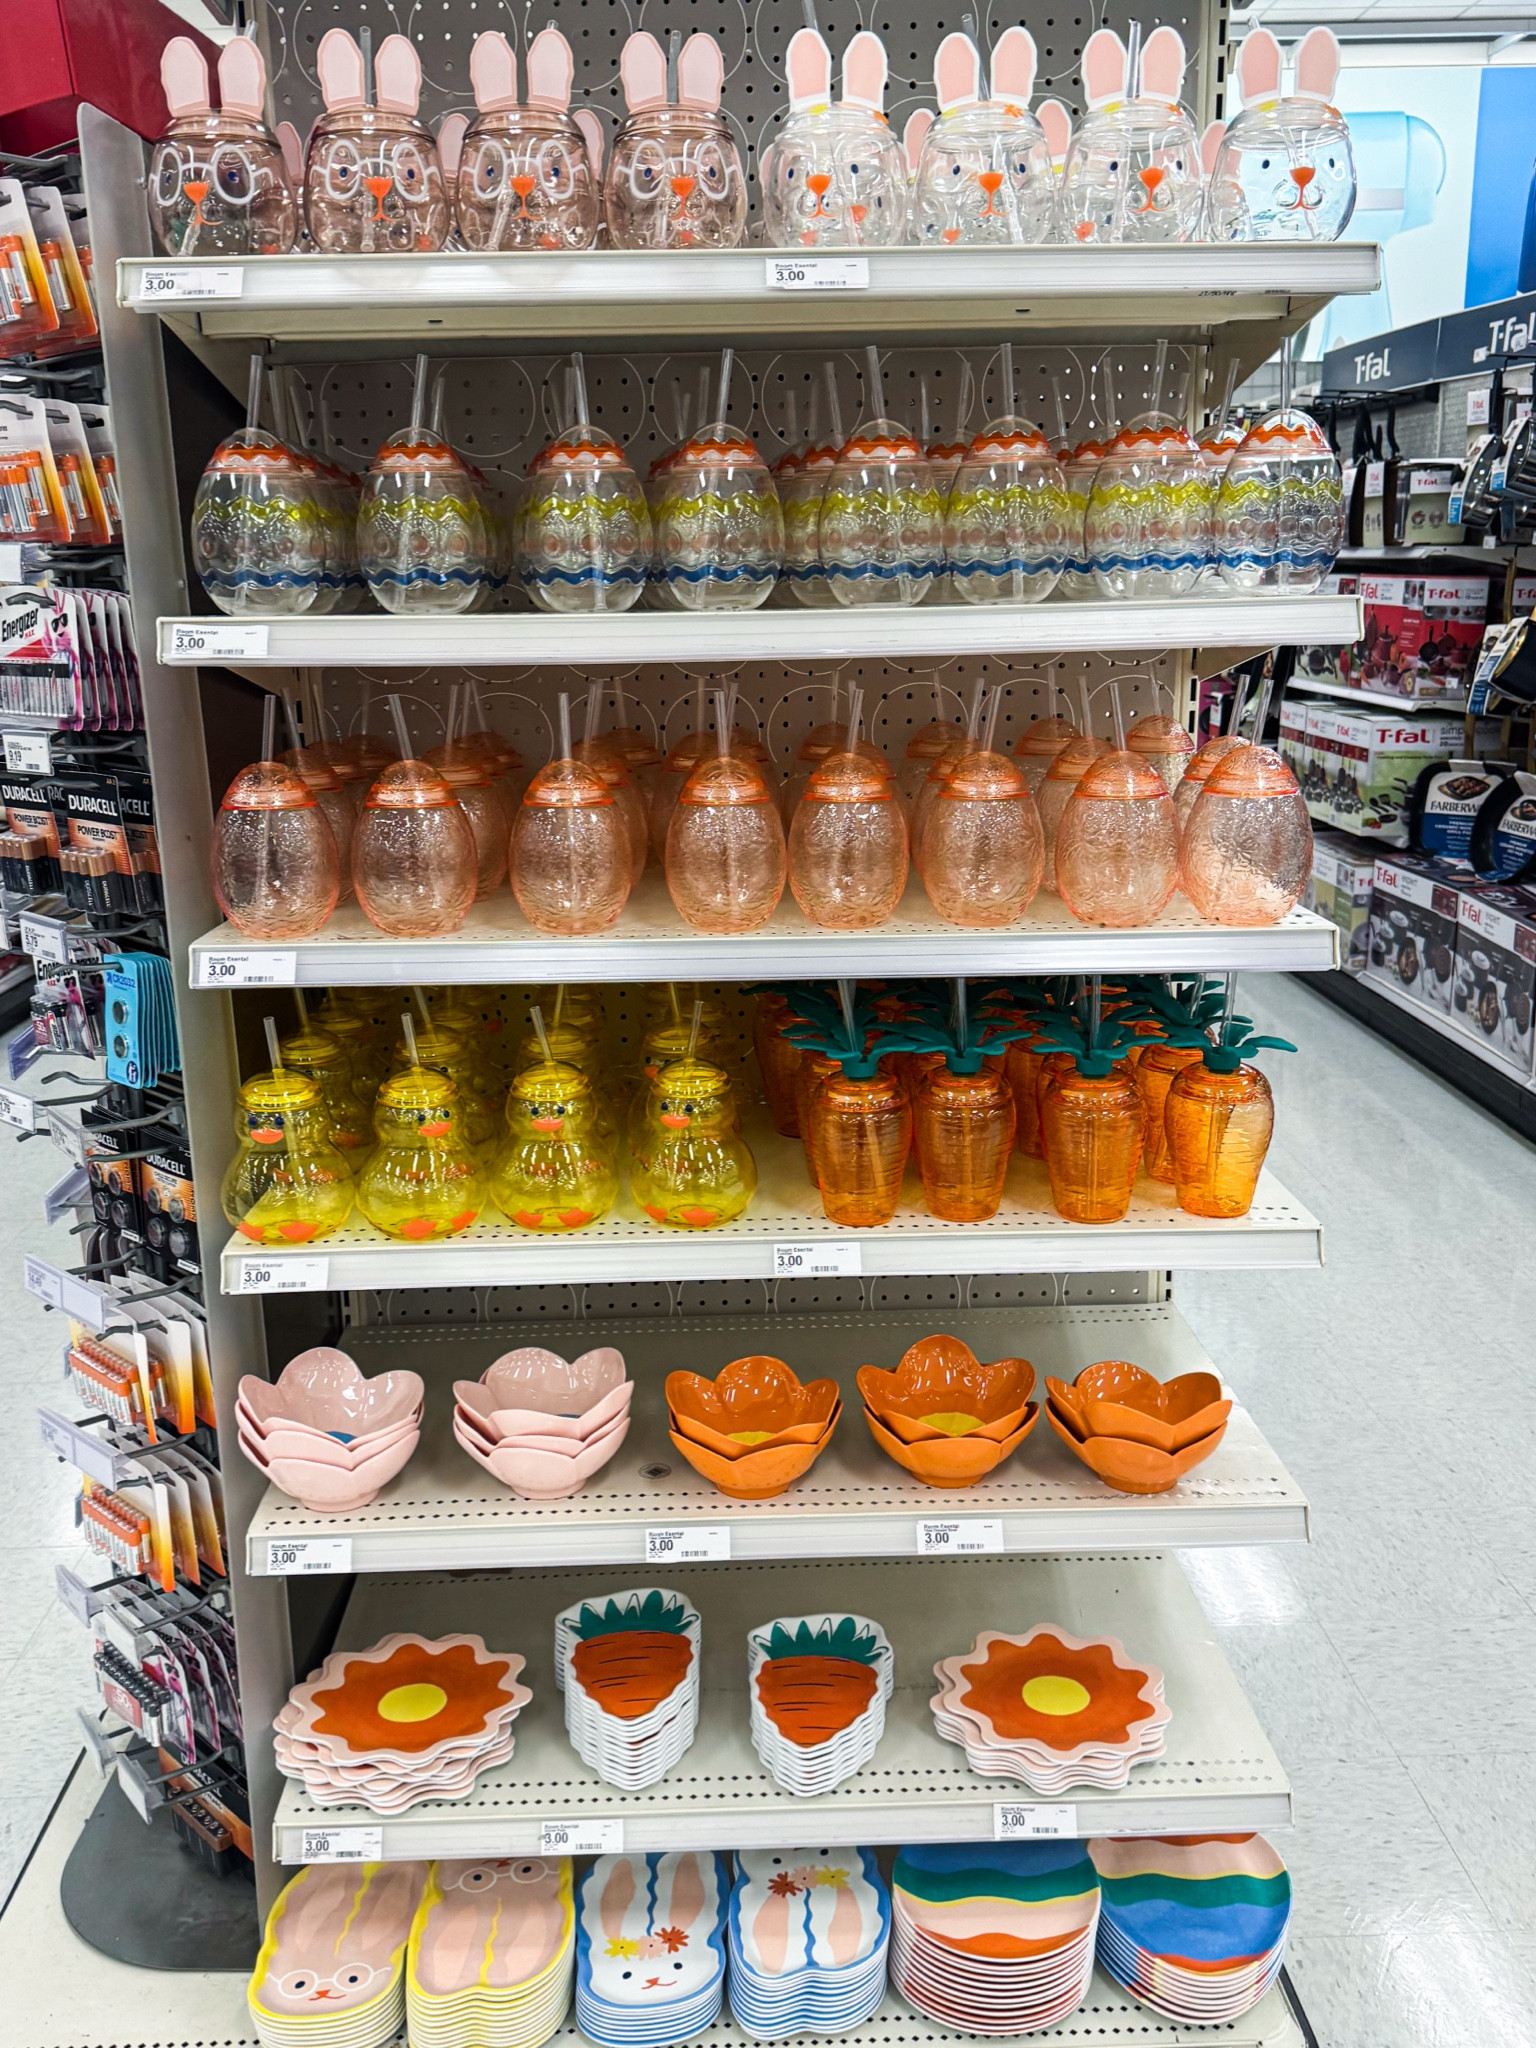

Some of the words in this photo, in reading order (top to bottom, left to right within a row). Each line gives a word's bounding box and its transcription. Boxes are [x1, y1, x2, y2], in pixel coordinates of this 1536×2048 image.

[776, 271, 805, 281] 3.00
[145, 280, 175, 290] 3.00
[1516, 588, 1536, 598] T-fa
[2, 608, 38, 643] Energizer
[176, 637, 205, 648] 3.00
[1440, 725, 1465, 735] simp
[2, 784, 47, 804] DURACELL
[68, 794, 118, 817] DURACELL
[121, 797, 150, 817] ACELL
[1430, 801, 1478, 813] FARBERW
[77, 825, 99, 837] POWER
[208, 964, 236, 976] 3.00
[777, 1255, 803, 1266] 3.00
[244, 1271, 271, 1282] 3.00
[924, 1532, 949, 1544] 3.00
[649, 1539, 674, 1551] 3.00
[271, 1552, 297, 1563] 3.00
[1001, 1814, 1025, 1826] 3.00
[544, 1832, 569, 1844] 3.00
[305, 1840, 330, 1852] 3.00
